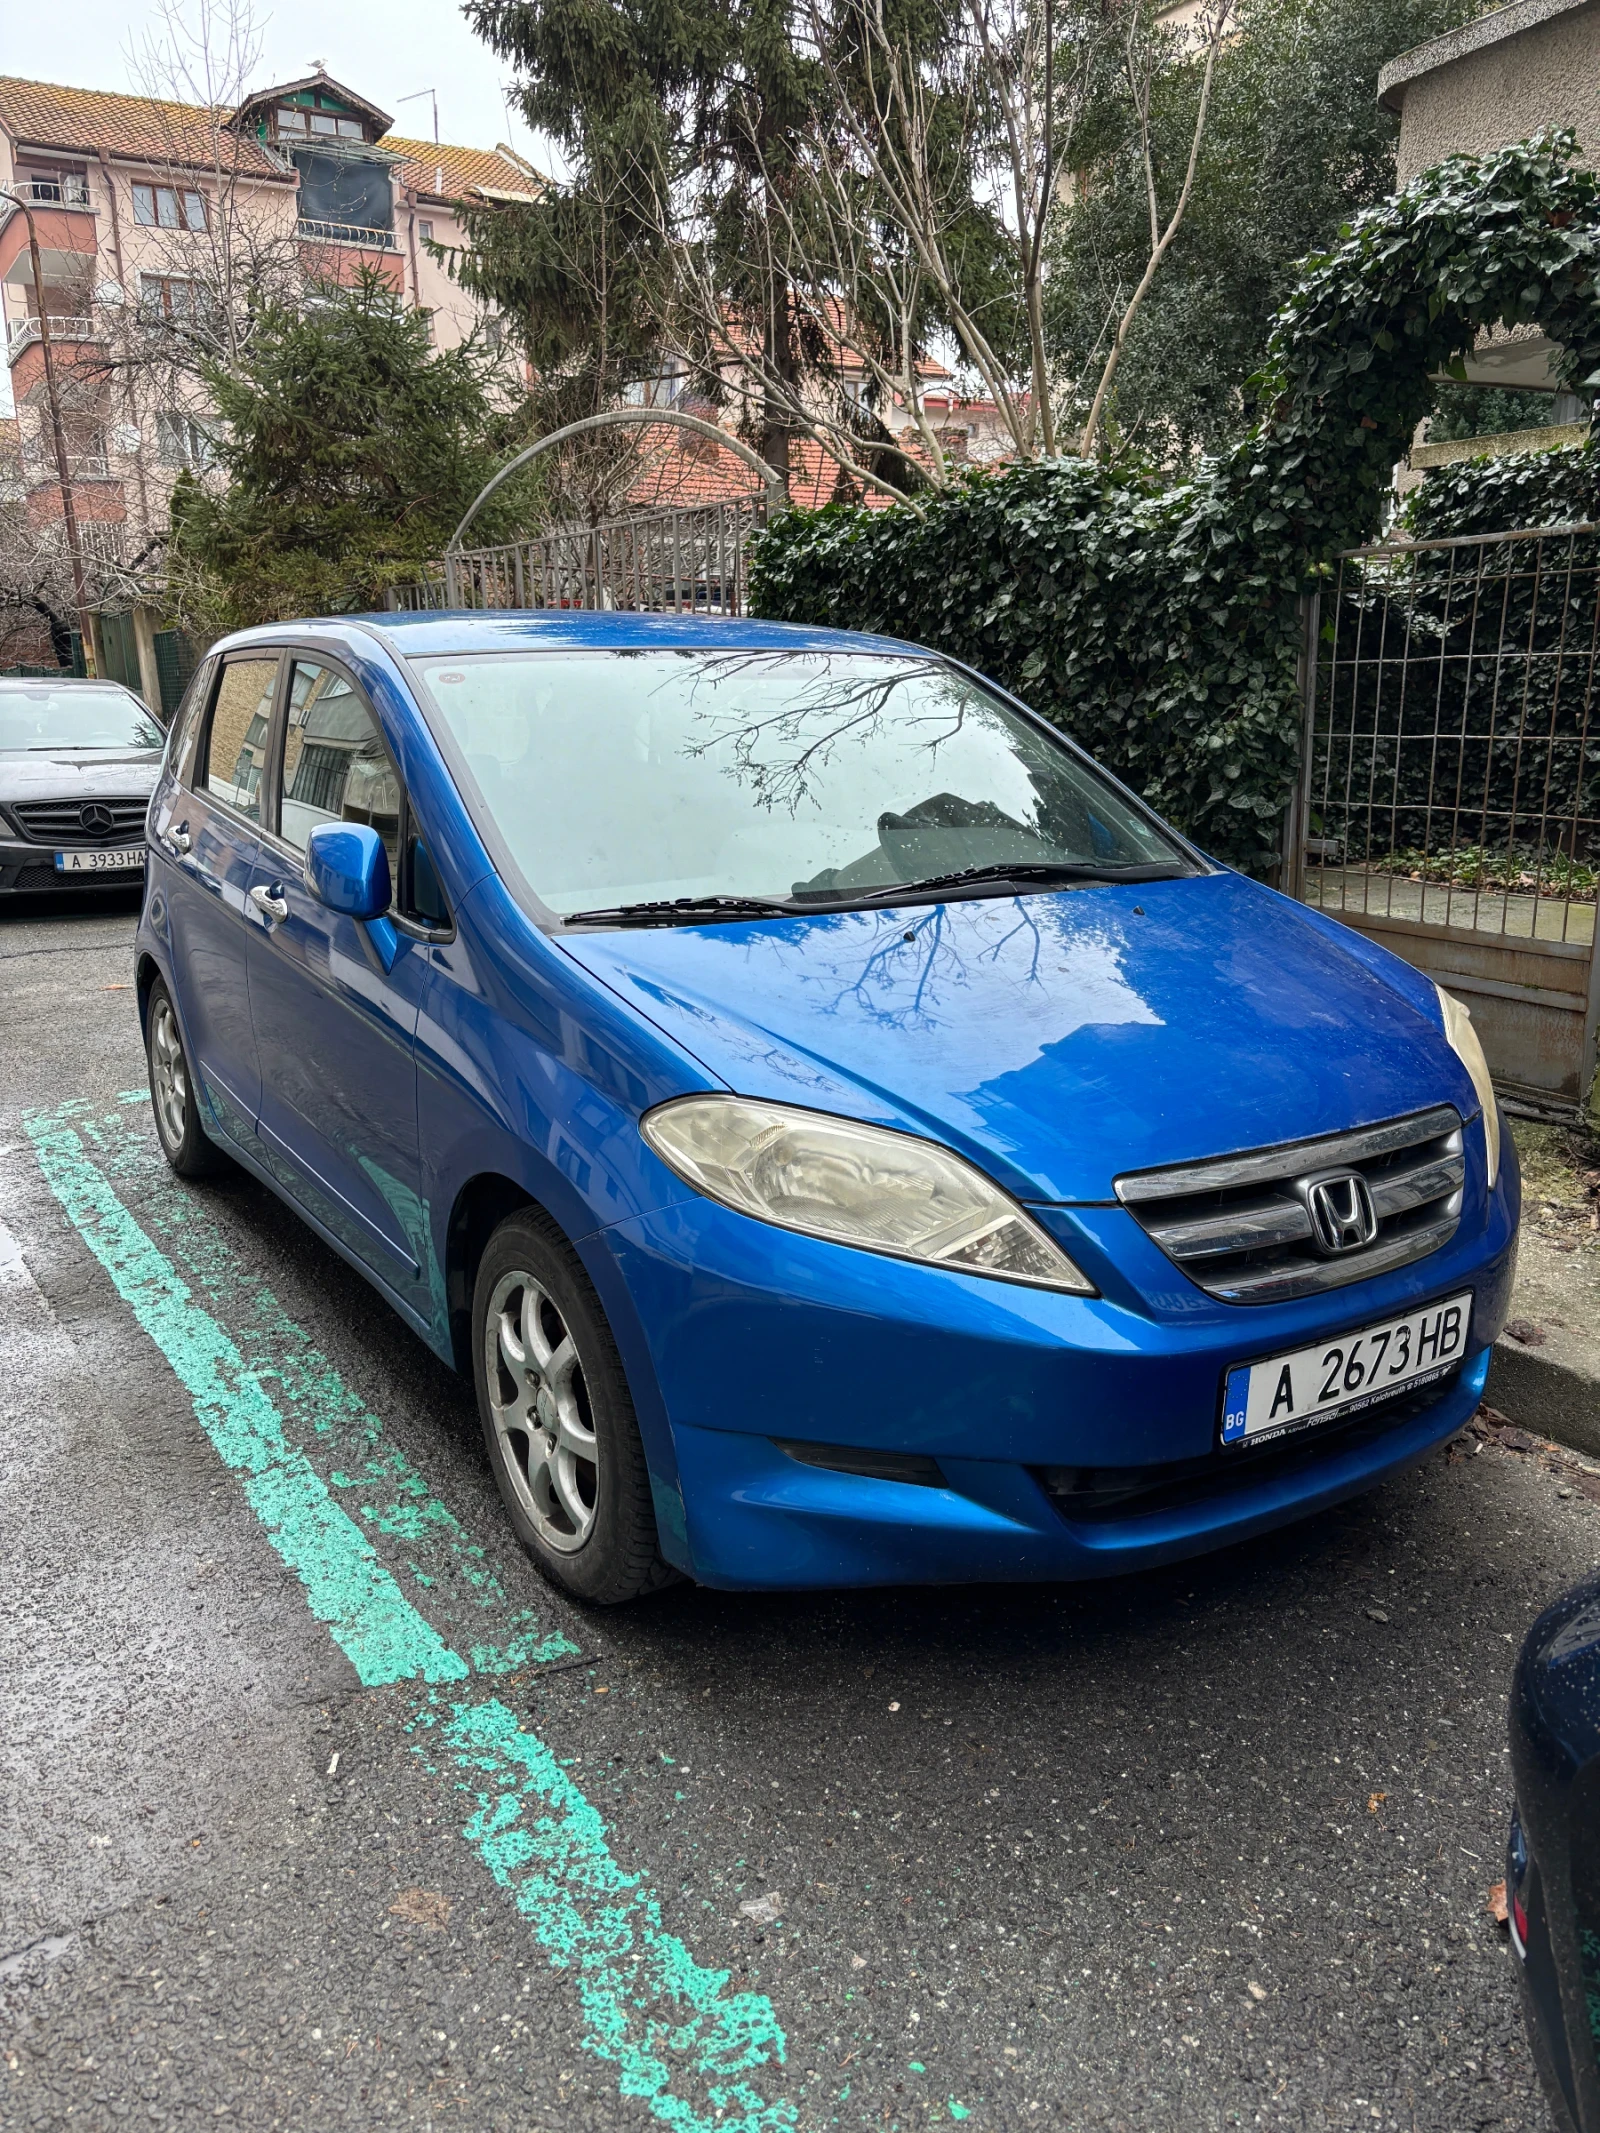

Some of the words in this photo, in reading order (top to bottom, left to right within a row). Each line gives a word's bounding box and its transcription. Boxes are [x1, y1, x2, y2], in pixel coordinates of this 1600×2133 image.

[72, 854, 82, 868] A
[1268, 1362, 1294, 1420] A
[1225, 1410, 1245, 1431] BG
[1250, 1428, 1287, 1446] HONDA
